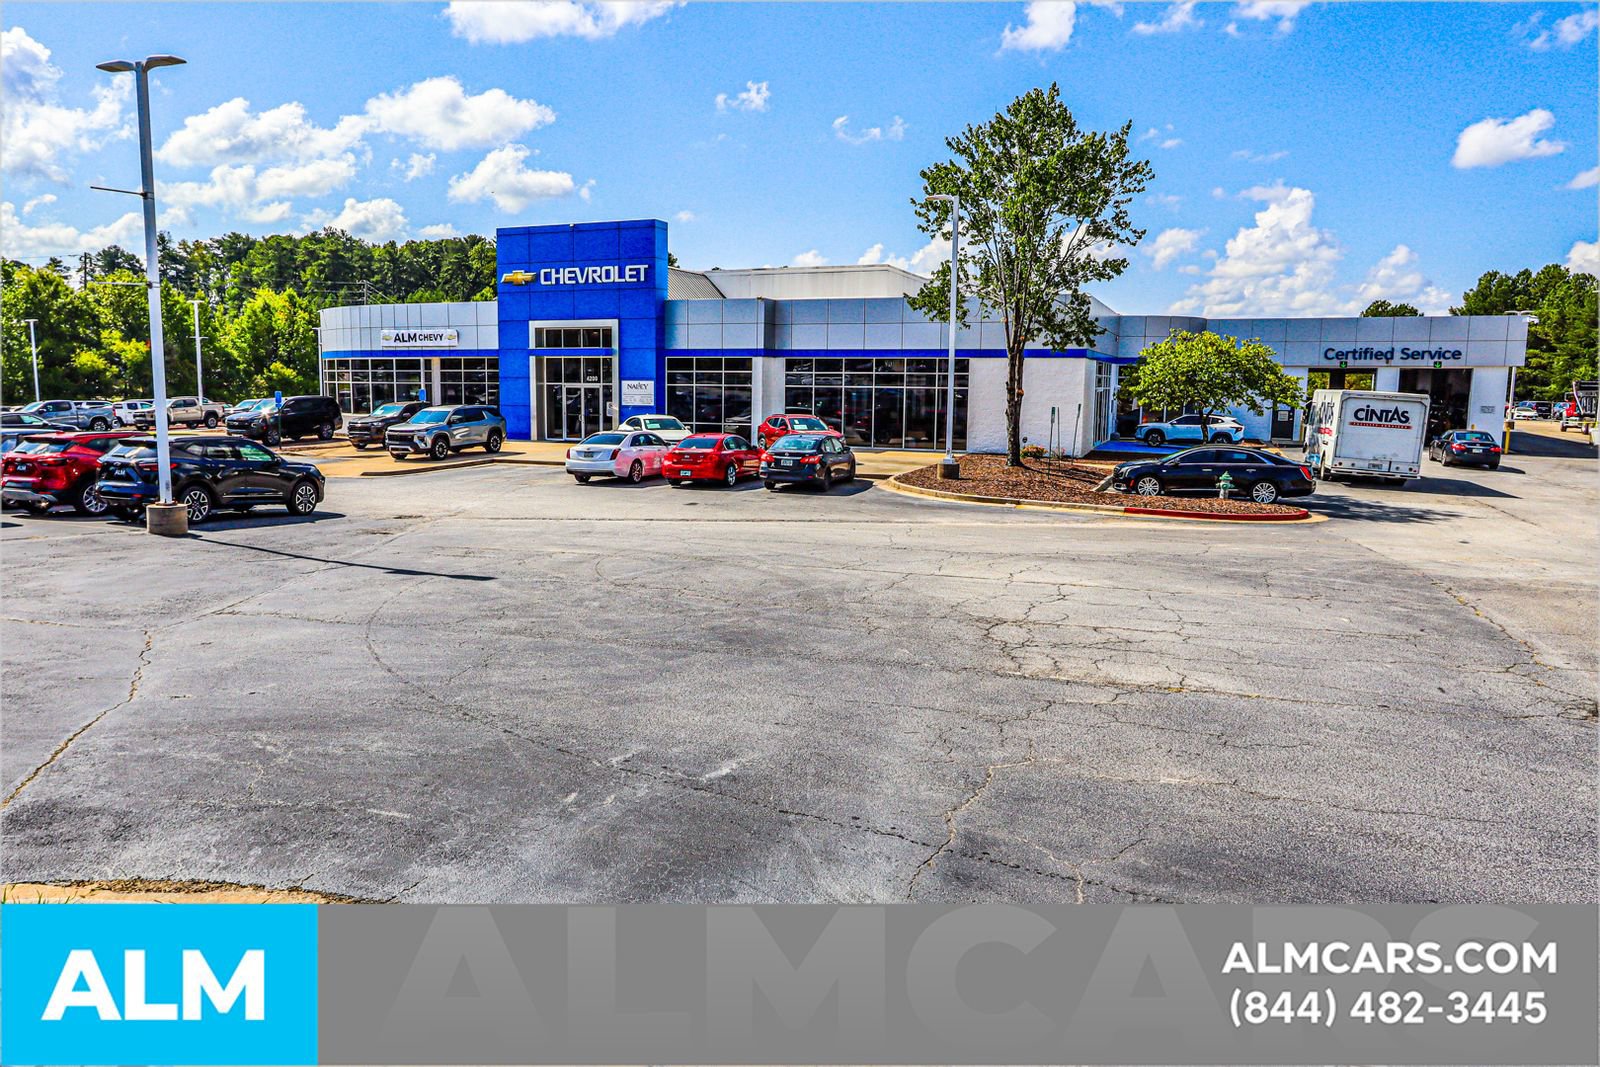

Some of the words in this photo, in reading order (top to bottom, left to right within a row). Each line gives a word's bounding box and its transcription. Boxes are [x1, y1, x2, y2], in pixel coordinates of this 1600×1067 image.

[540, 264, 649, 285] CHEVROLET
[394, 333, 417, 342] ALM
[418, 333, 444, 341] CHEVY
[1324, 347, 1395, 360] Certified
[1400, 347, 1462, 360] Service
[1354, 404, 1410, 424] CINTAS
